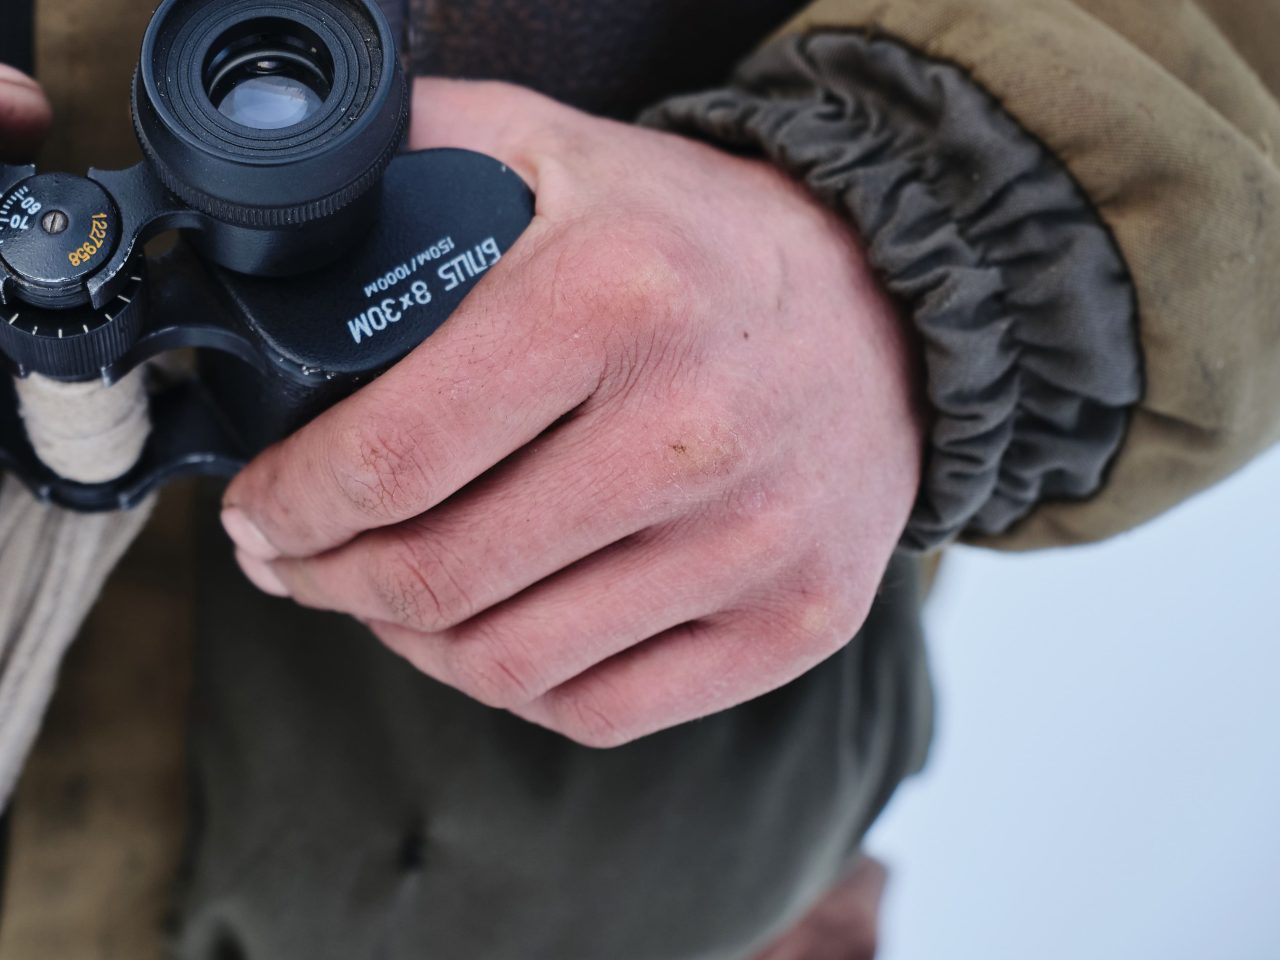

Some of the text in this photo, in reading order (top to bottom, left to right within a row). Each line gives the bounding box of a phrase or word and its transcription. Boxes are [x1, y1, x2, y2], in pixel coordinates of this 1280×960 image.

[9, 214, 29, 230] 70
[21, 196, 41, 215] 60
[67, 212, 108, 267] 1227958
[437, 237, 501, 291] БПЦ5
